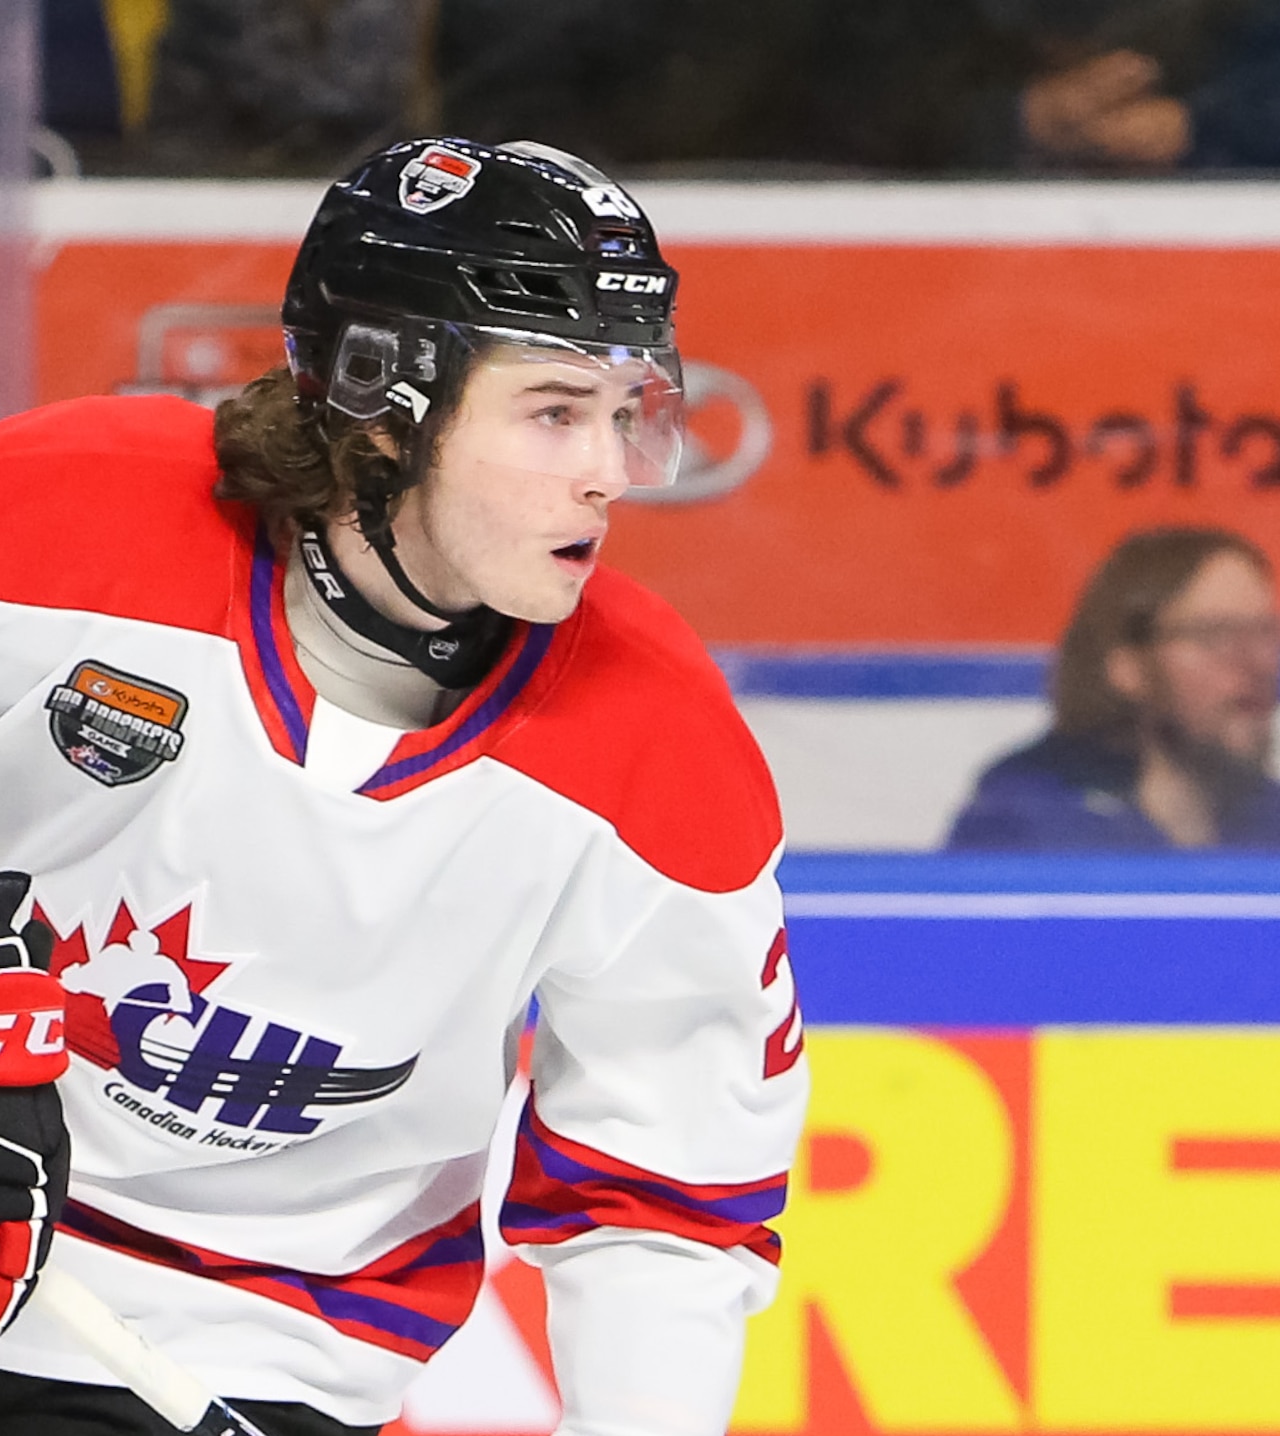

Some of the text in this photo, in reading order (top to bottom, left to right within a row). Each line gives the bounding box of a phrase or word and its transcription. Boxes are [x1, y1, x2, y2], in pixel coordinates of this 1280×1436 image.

[596, 271, 668, 294] CCM
[109, 982, 344, 1135] CHL
[103, 1081, 276, 1156] Canadian Hockey
